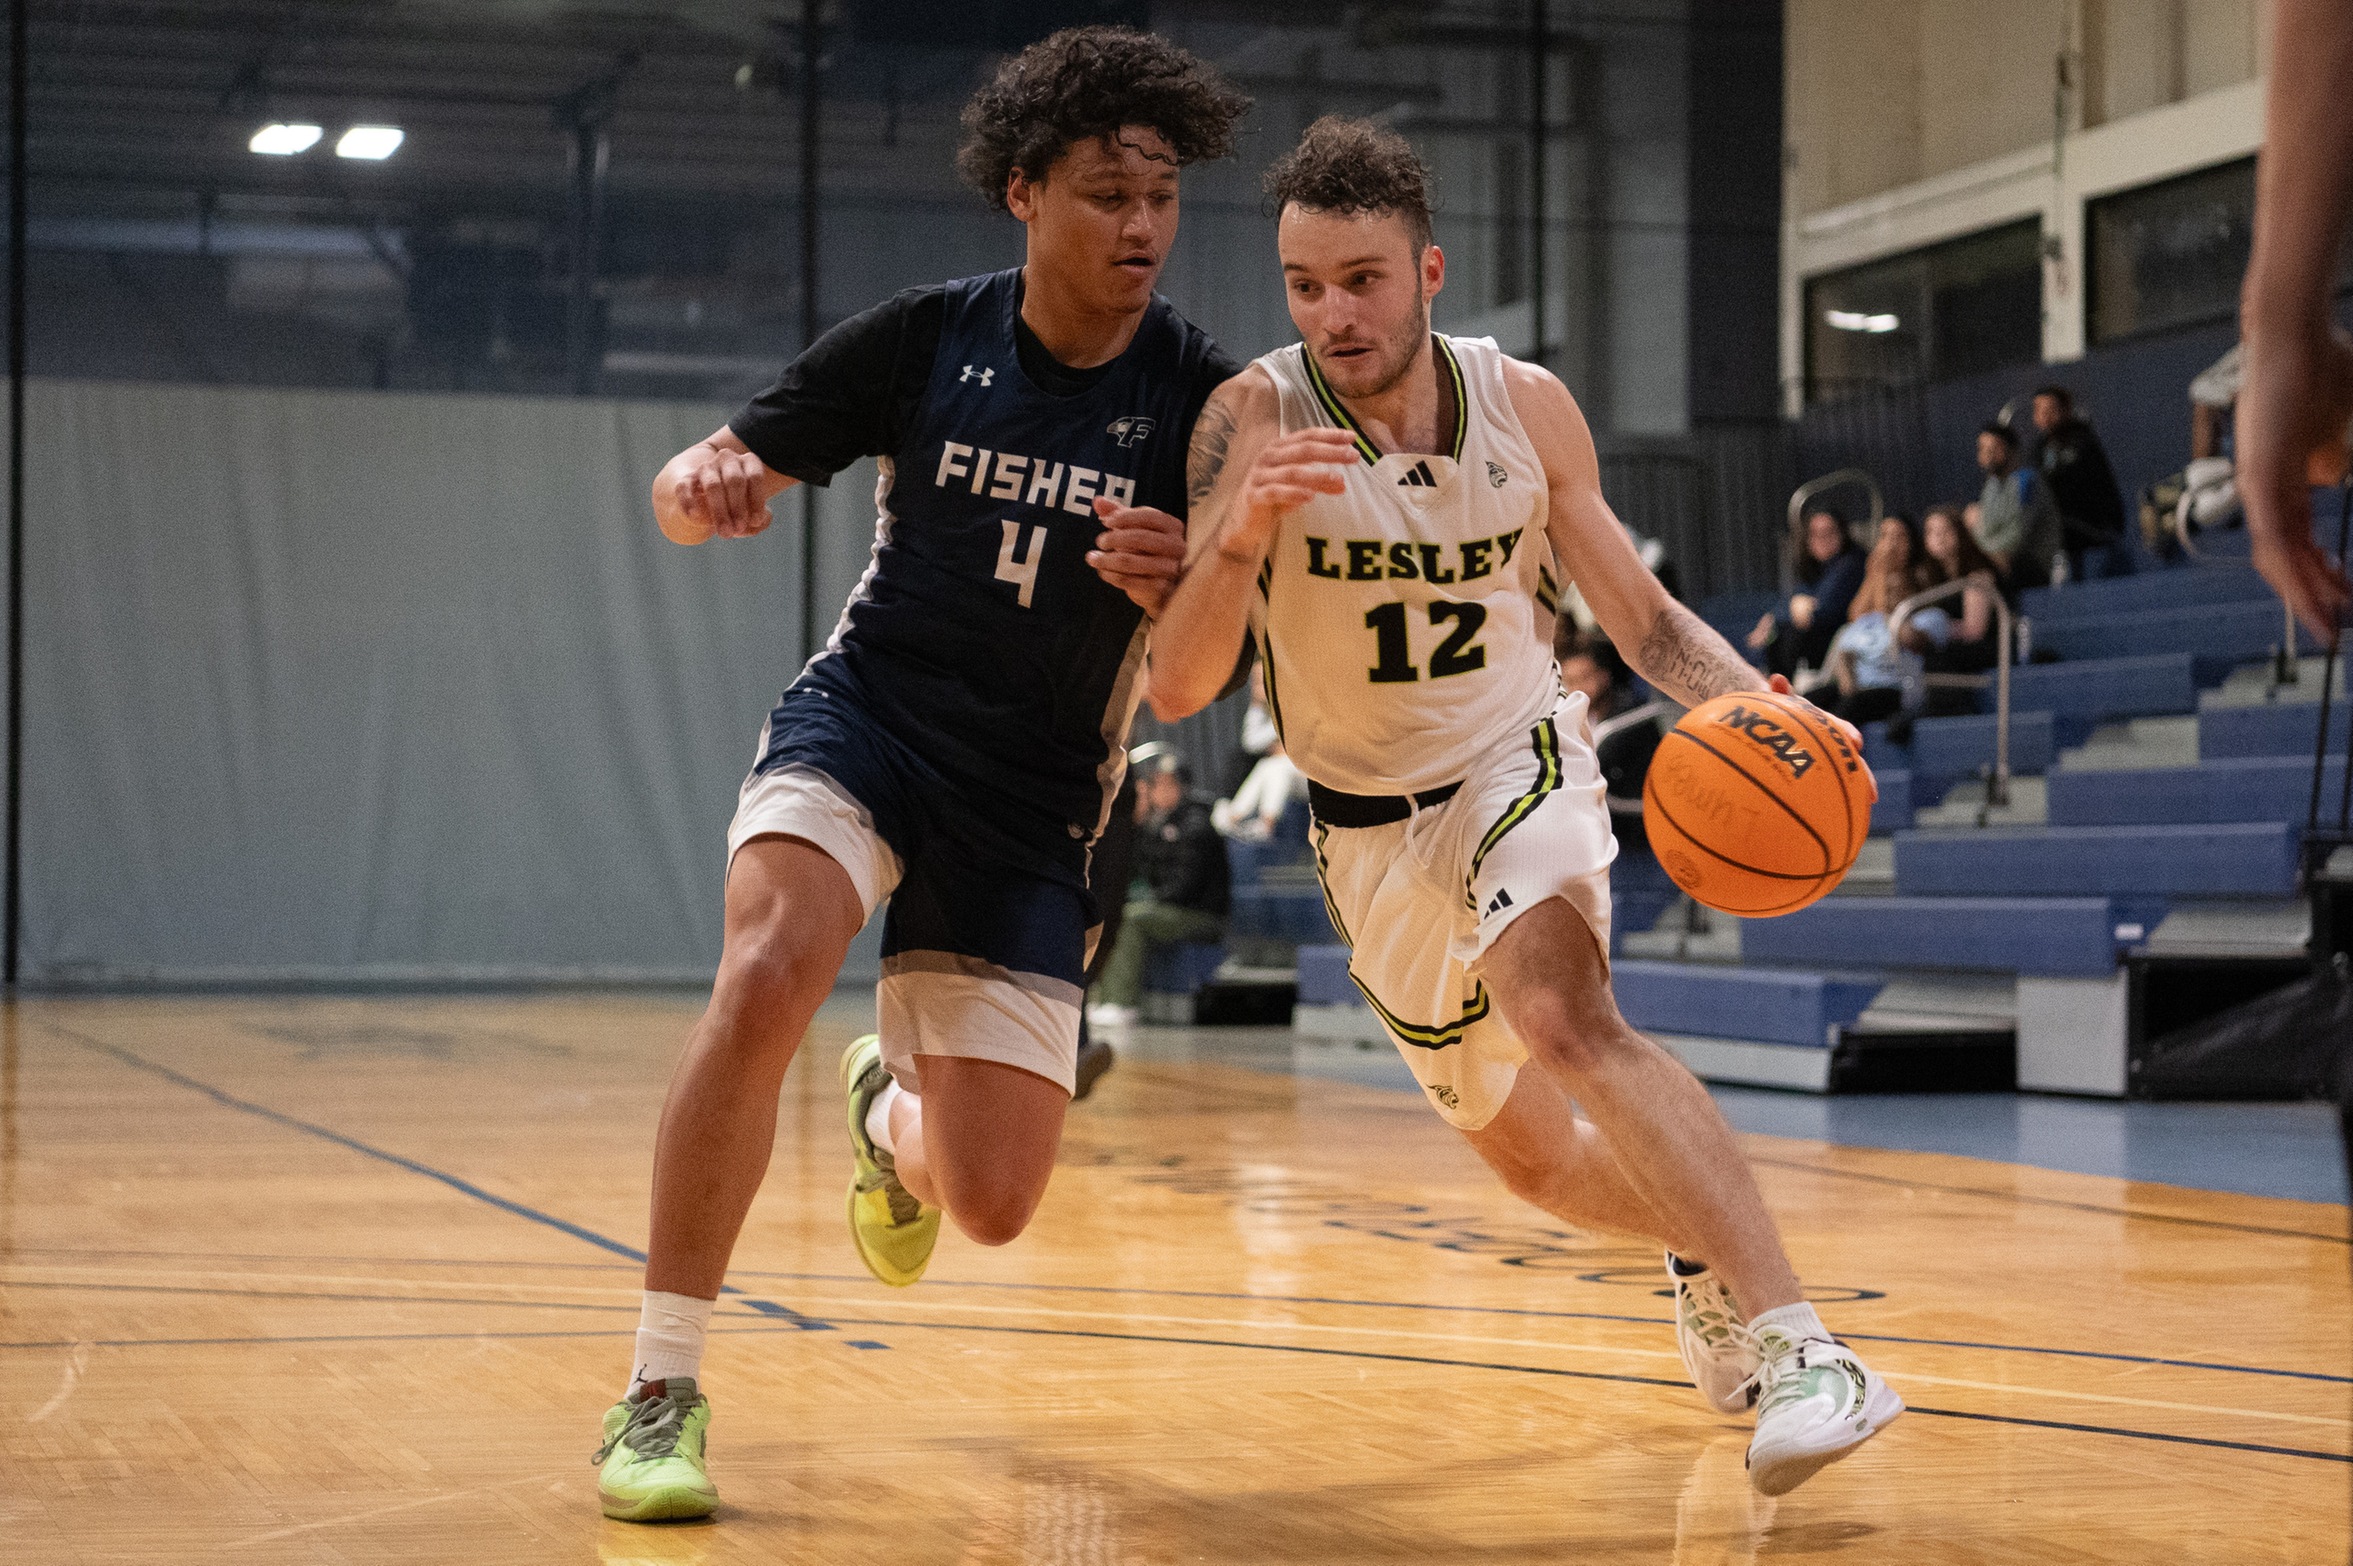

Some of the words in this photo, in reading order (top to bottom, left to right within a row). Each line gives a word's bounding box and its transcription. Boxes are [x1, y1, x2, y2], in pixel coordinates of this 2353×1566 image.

[994, 519, 1048, 609] 4
[1304, 526, 1525, 585] LESLEY
[1364, 600, 1488, 684] 12
[1718, 706, 1816, 779] NCAA
